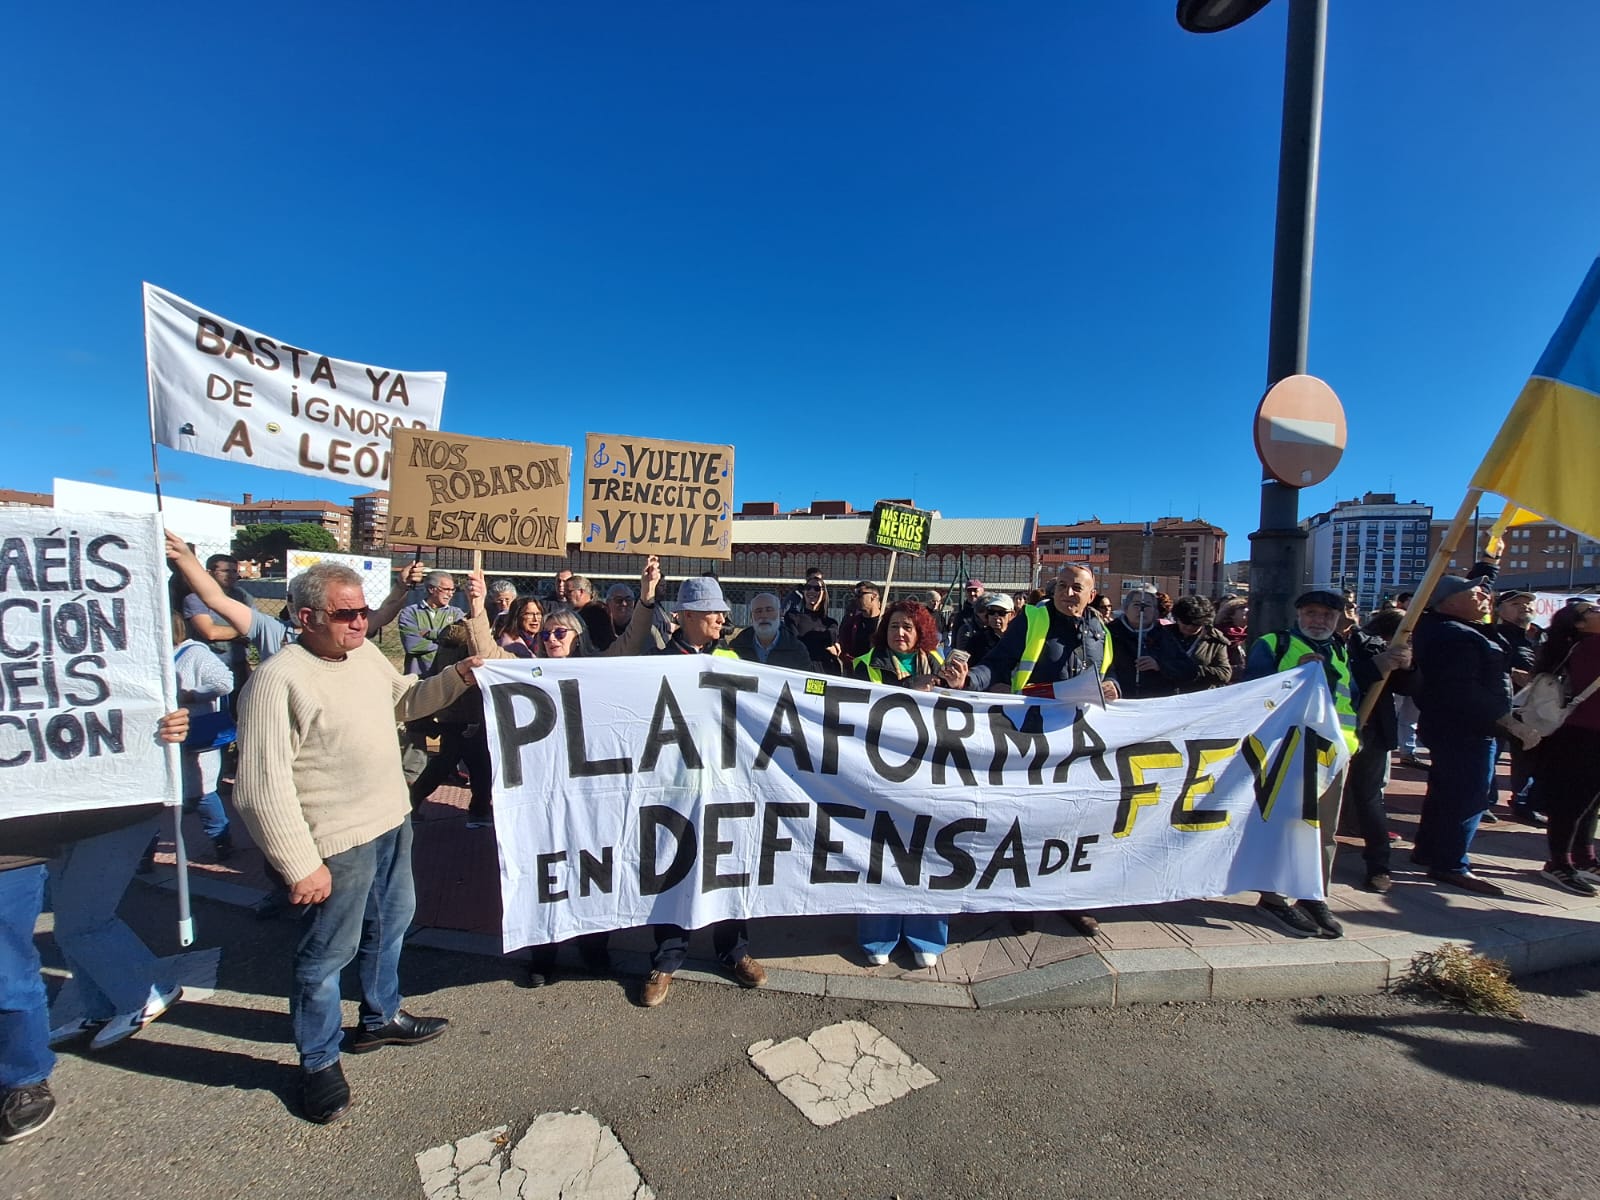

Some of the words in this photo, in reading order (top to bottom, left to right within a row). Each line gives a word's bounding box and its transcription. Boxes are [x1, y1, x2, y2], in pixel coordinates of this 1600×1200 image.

[195, 316, 337, 389] BASTA
[365, 368, 410, 406] YA
[206, 373, 254, 407] DE
[221, 419, 254, 457] A
[408, 437, 469, 471] NOS
[425, 457, 564, 506] ROBARON
[621, 444, 723, 485] VUELVE
[588, 478, 723, 512] TRENECITO,
[389, 516, 419, 538] LA
[426, 507, 560, 550] ESTACIÓN
[597, 509, 720, 547] VUELVE
[879, 520, 923, 542] MENOS
[899, 512, 919, 526] FEVE
[920, 516, 927, 527] Y
[876, 535, 892, 546] TREN
[0, 593, 128, 659] CIÓN
[489, 671, 1114, 788] PLATAFORMA
[537, 846, 613, 903] EN
[638, 801, 1031, 896] DEFENSA
[1038, 835, 1099, 876] DE
